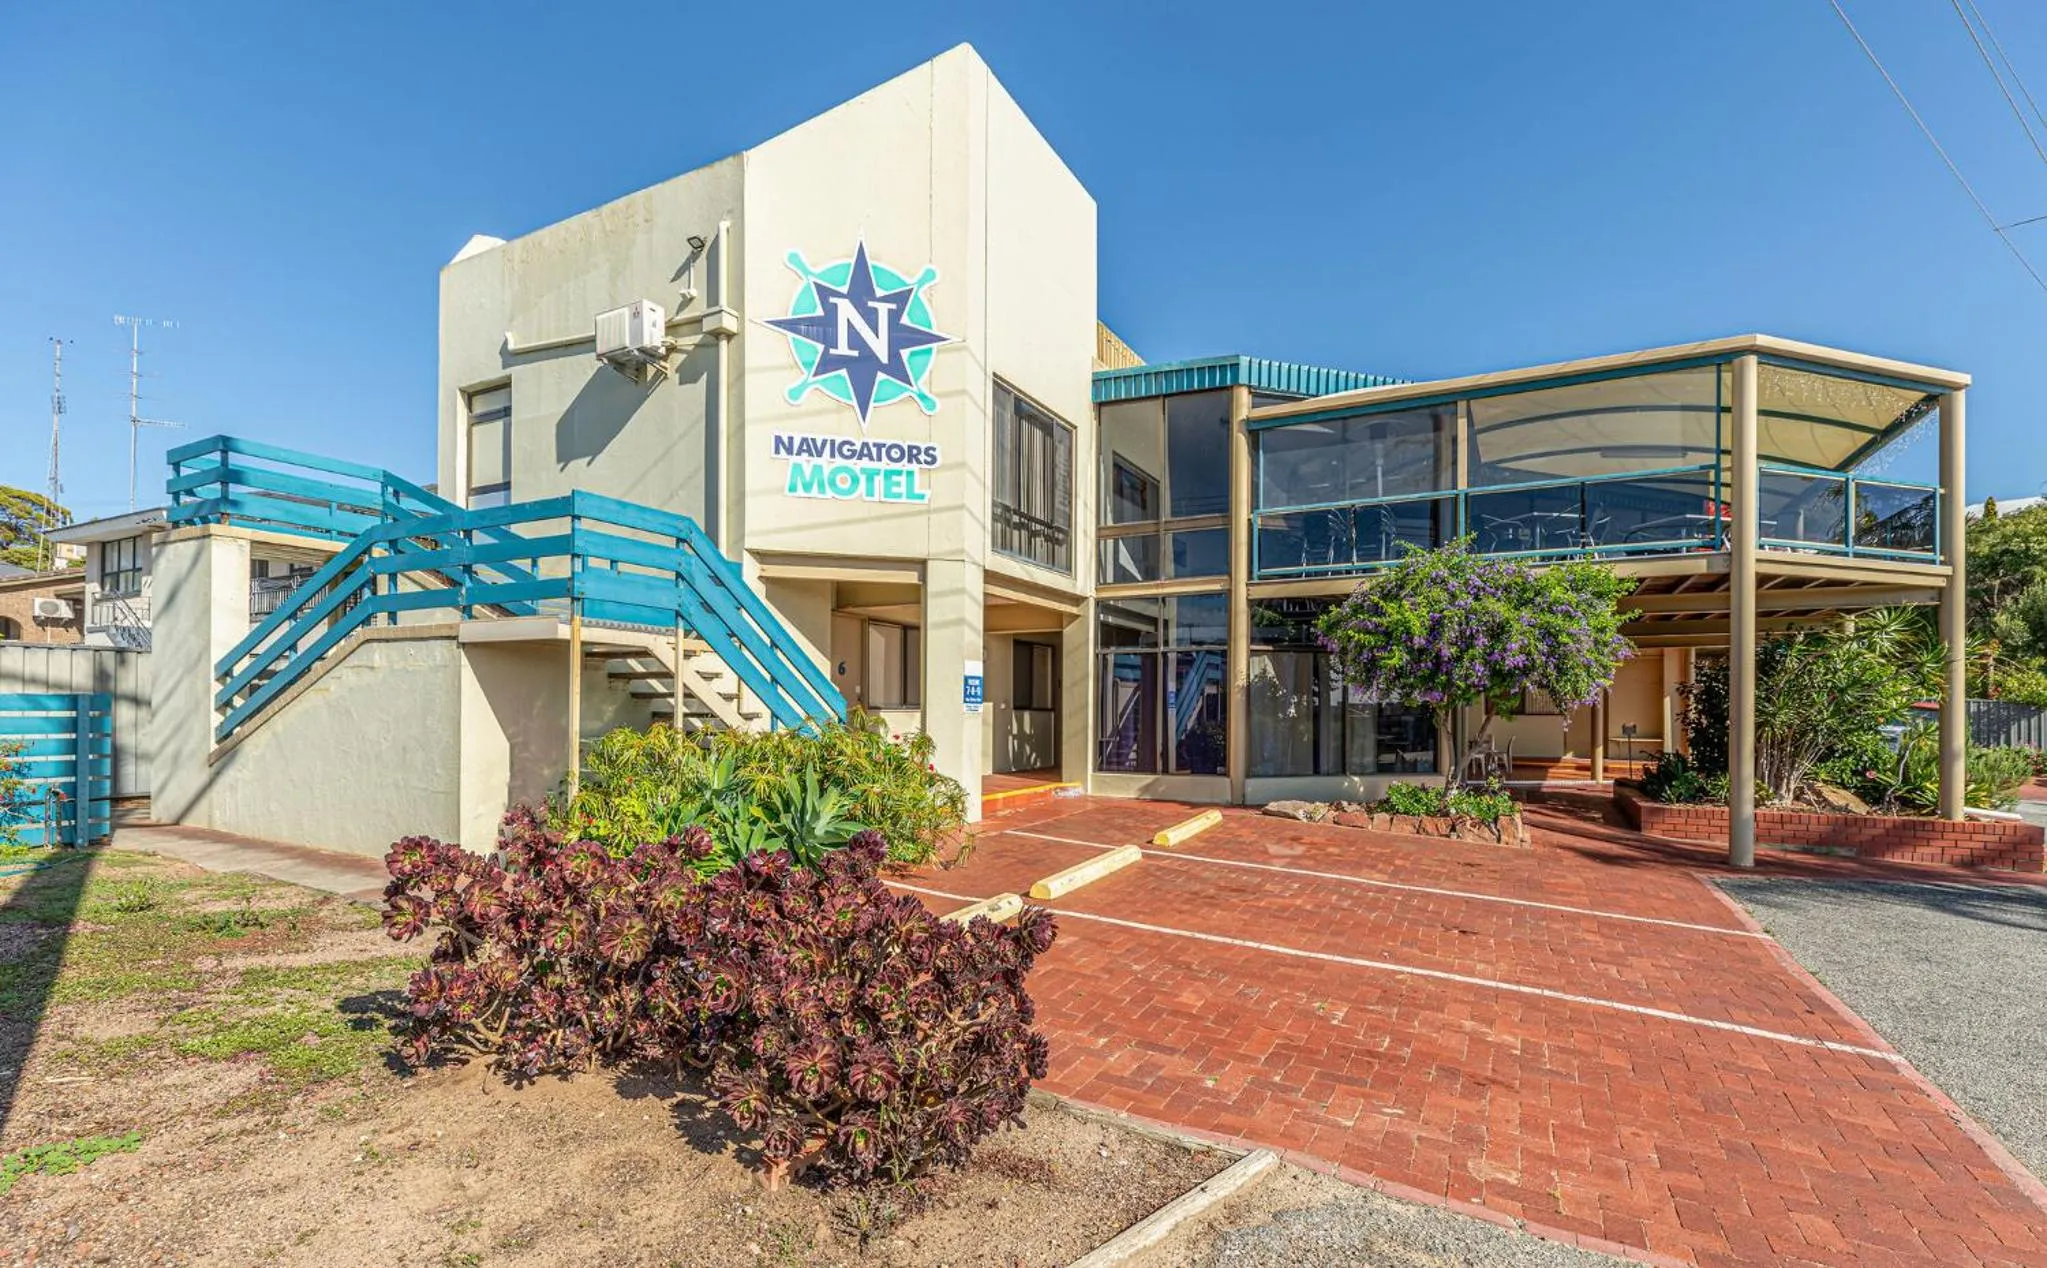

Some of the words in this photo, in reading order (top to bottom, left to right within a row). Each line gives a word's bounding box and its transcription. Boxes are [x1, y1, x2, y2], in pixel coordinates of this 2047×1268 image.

[829, 296, 897, 365] N
[774, 434, 938, 466] NAVIGATORS
[788, 462, 926, 500] MOTEL
[838, 660, 846, 676] 6
